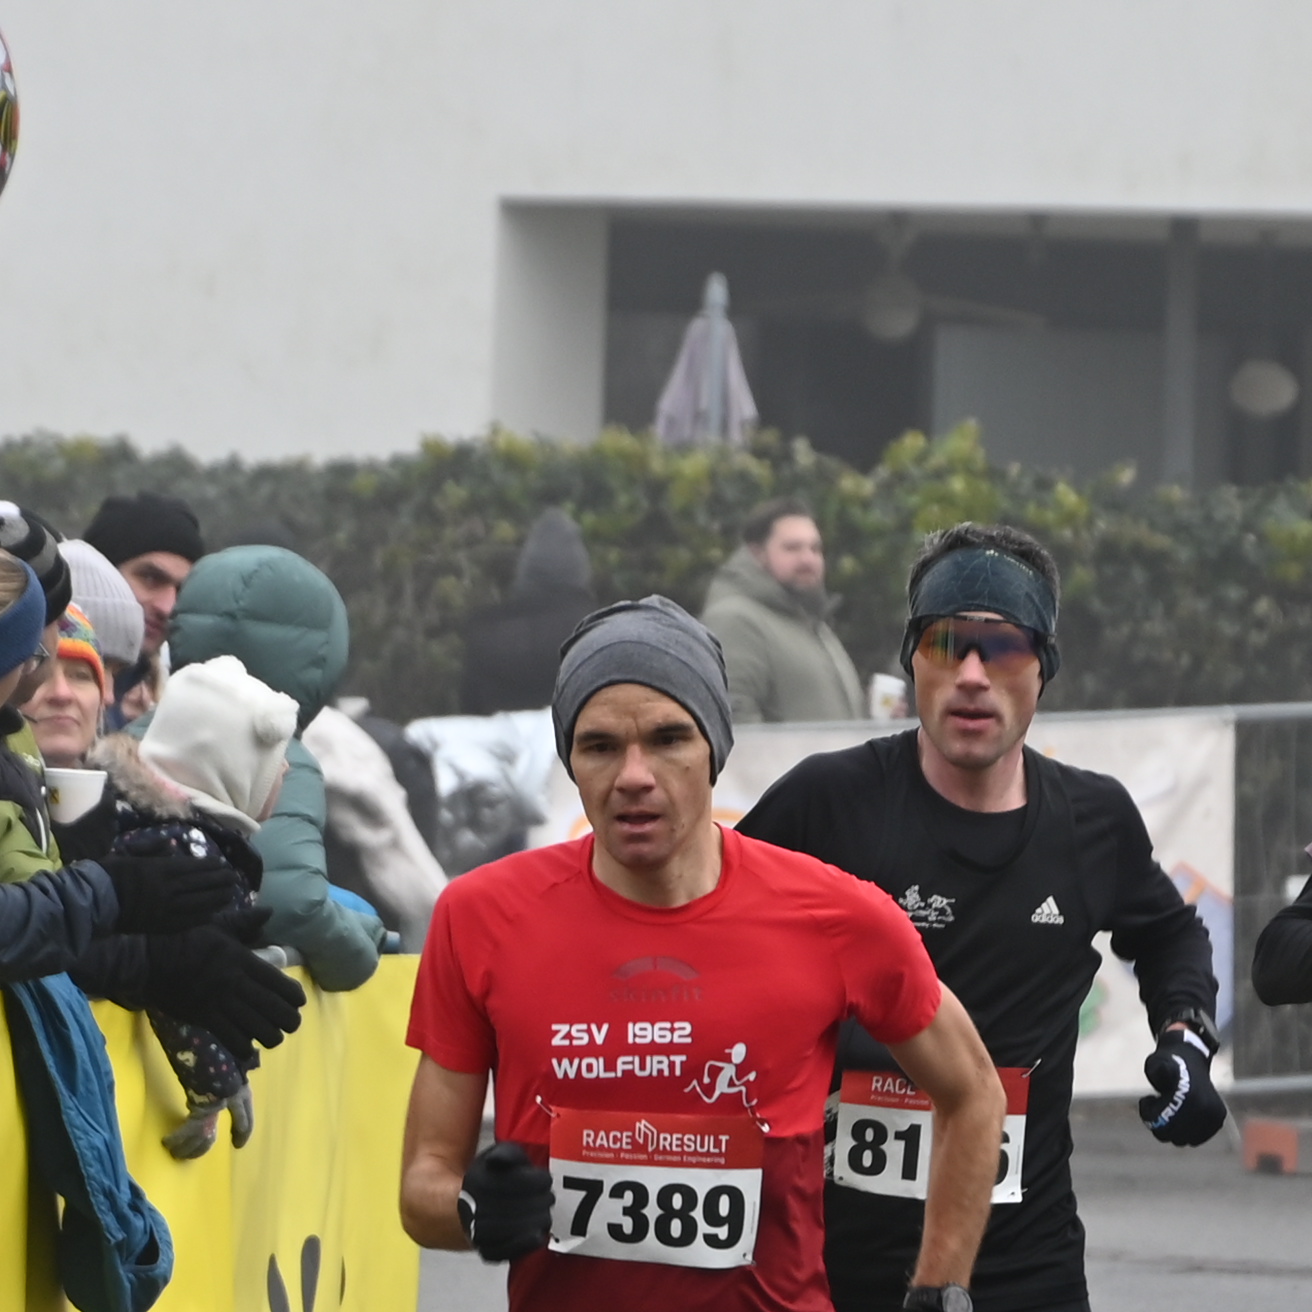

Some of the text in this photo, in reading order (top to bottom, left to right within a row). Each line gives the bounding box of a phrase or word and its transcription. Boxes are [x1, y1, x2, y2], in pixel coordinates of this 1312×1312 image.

[1031, 913, 1064, 925] adidas
[551, 1021, 692, 1046] ZSV 1962
[551, 1055, 687, 1079] WOLFURT
[583, 1130, 730, 1154] RACE RESULT
[683, 1155, 726, 1165] Engineering
[562, 1175, 746, 1250] 7389
